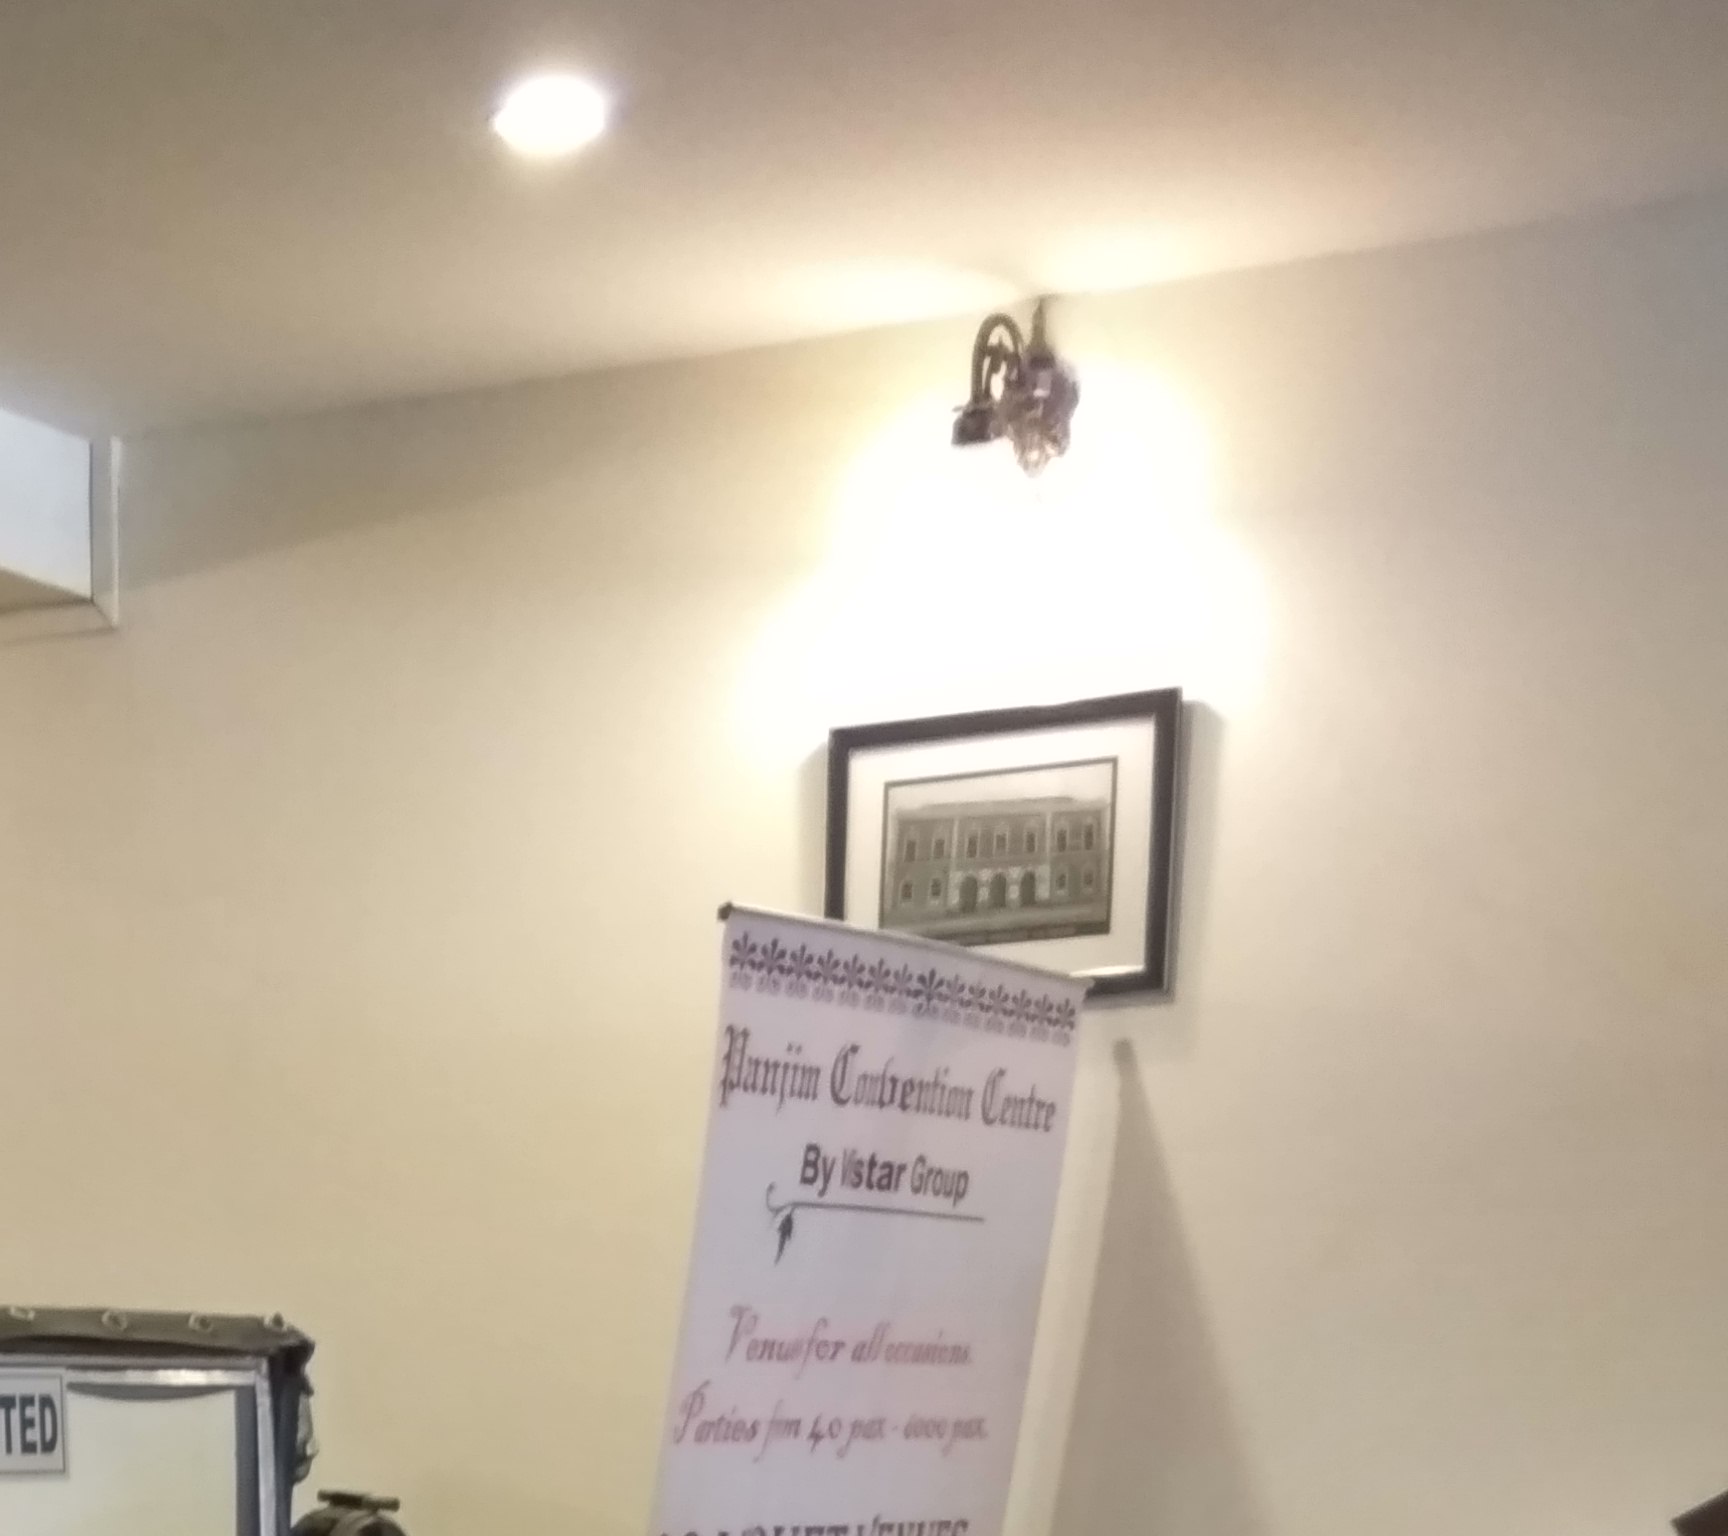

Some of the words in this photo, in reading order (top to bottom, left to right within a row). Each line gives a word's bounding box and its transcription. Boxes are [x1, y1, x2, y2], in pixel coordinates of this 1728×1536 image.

[720, 1024, 821, 1117] Panjim
[830, 1043, 974, 1121] Convention
[980, 1067, 1056, 1132] Centre
[799, 1143, 836, 1197] By
[910, 1155, 969, 1207] Group
[851, 1321, 891, 1363] all
[808, 1415, 842, 1453] 40
